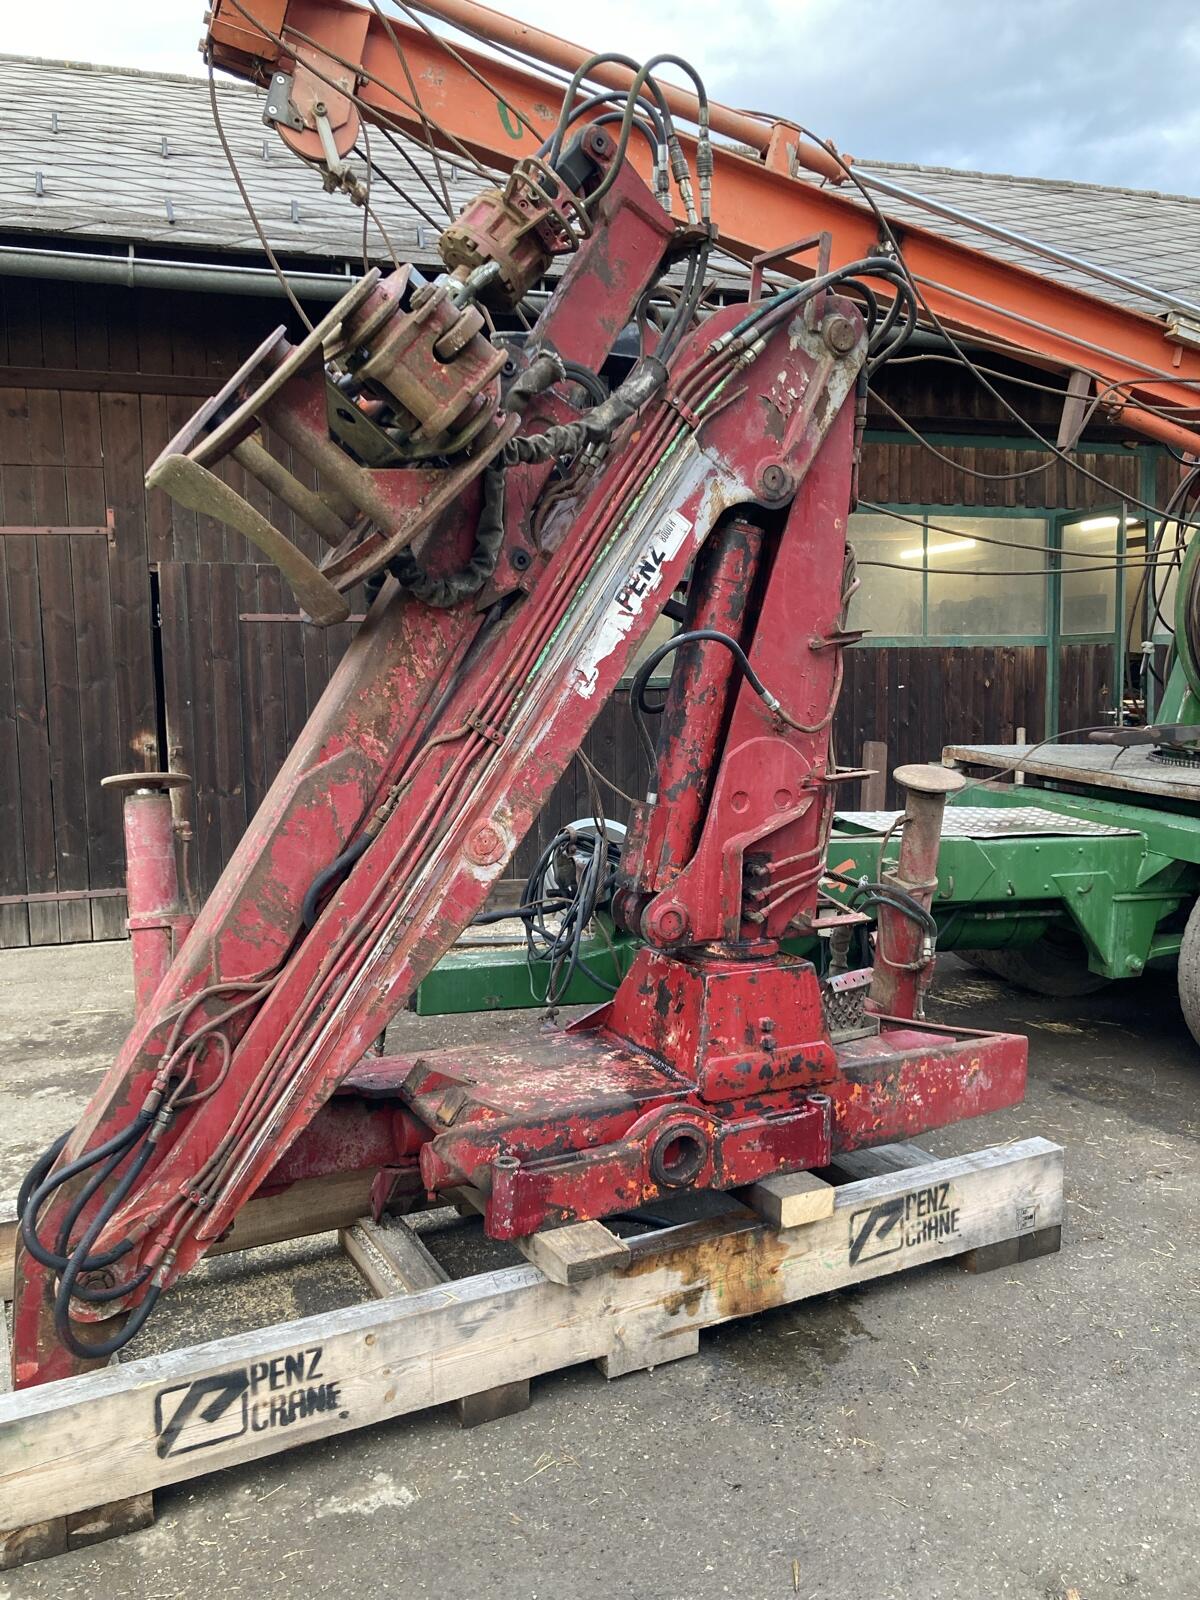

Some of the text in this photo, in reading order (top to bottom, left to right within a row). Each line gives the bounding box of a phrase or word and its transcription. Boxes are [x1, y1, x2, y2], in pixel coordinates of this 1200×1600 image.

[614, 547, 666, 612] PENZ
[904, 1182, 949, 1220] PENZ
[905, 1208, 960, 1247] CRANE
[251, 1347, 323, 1395] PENZ
[251, 1380, 342, 1432] CRANE
